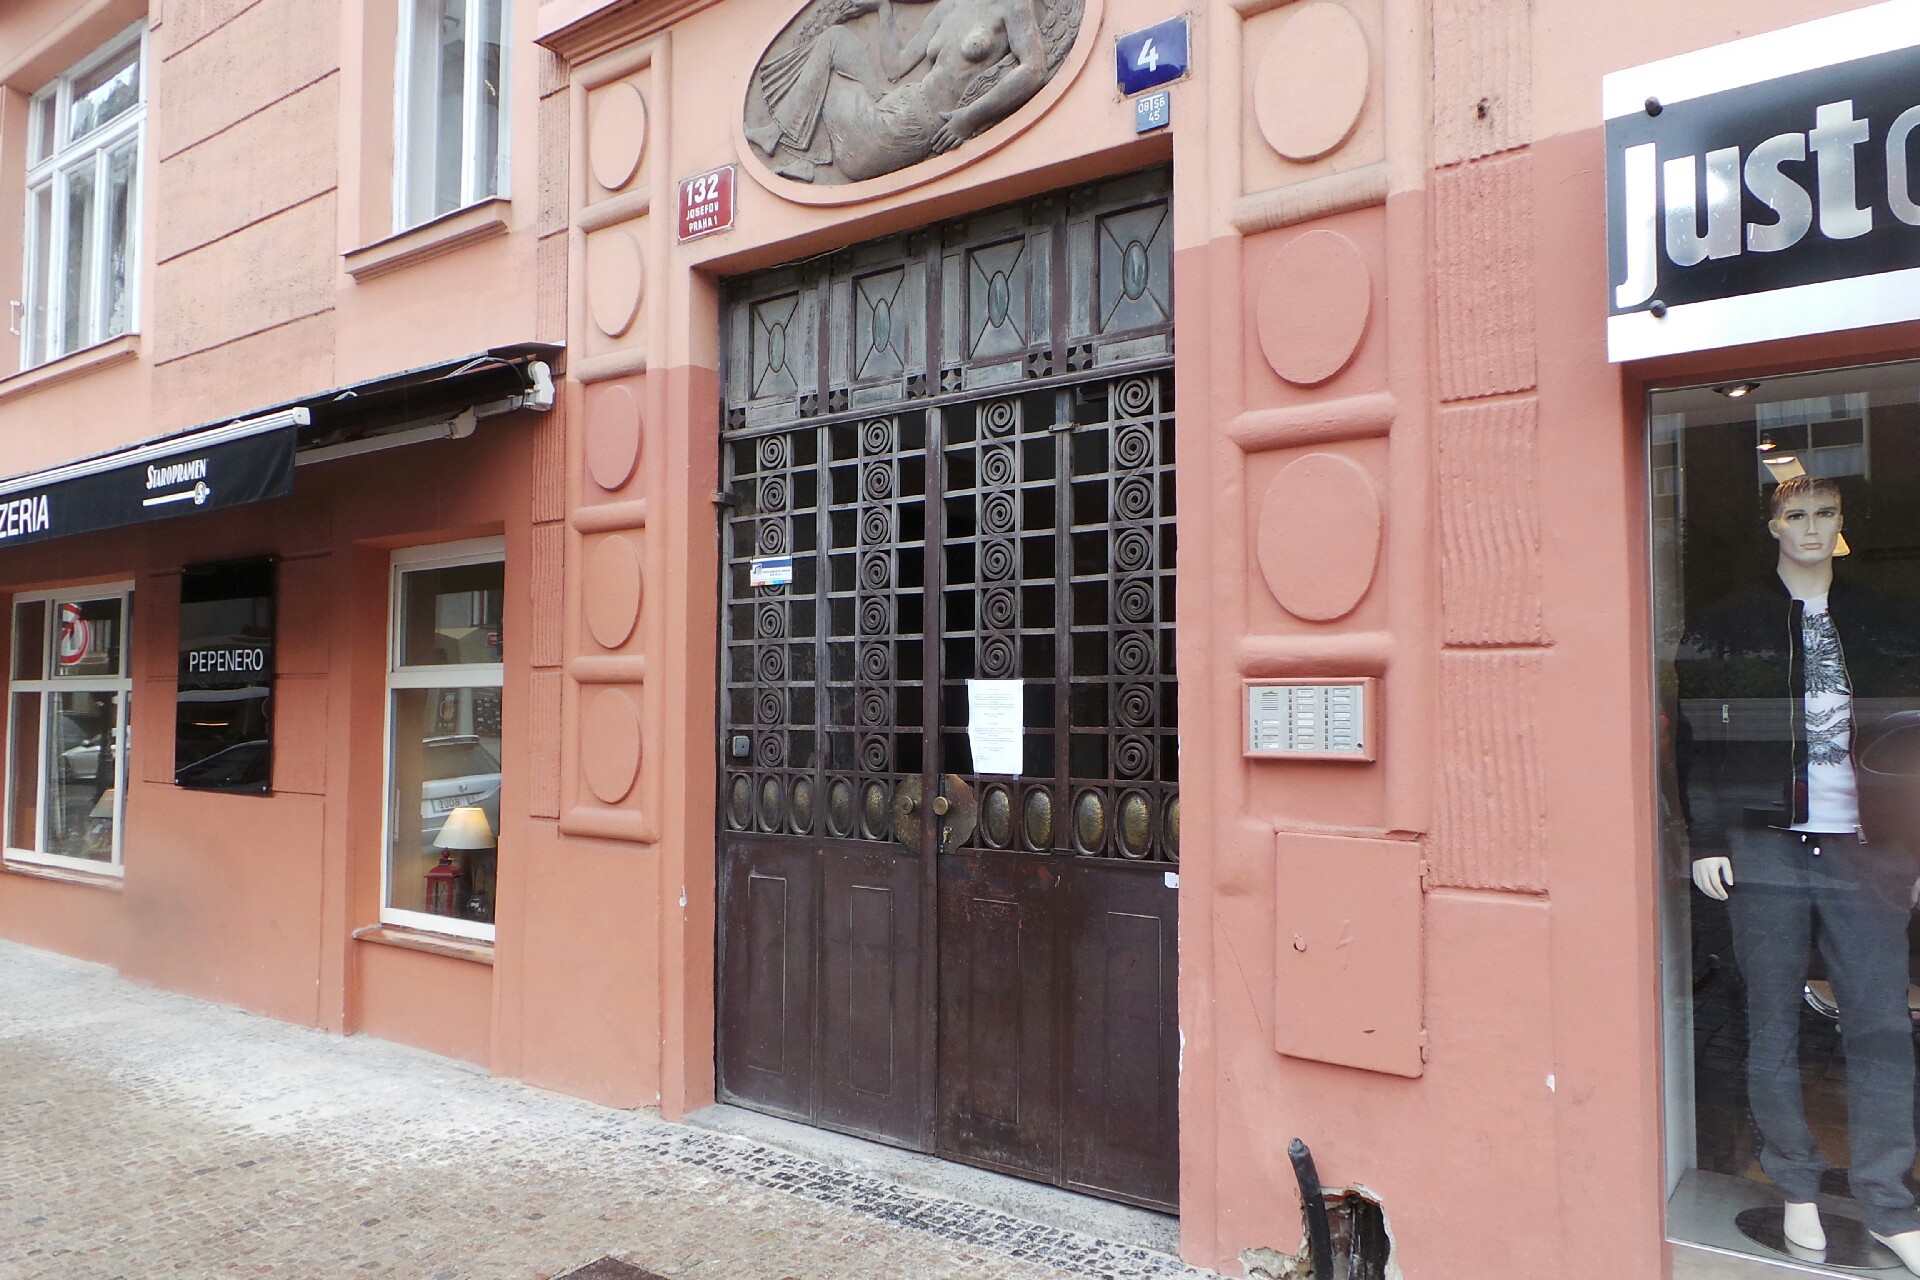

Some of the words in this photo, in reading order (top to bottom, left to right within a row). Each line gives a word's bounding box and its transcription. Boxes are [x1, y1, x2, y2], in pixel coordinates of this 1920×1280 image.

[1137, 37, 1159, 72] 4
[686, 173, 719, 206] 132
[686, 201, 719, 220] JOSEFOV
[688, 216, 713, 233] PRAHA
[713, 214, 718, 225] 1
[189, 648, 264, 672] PEPENERO
